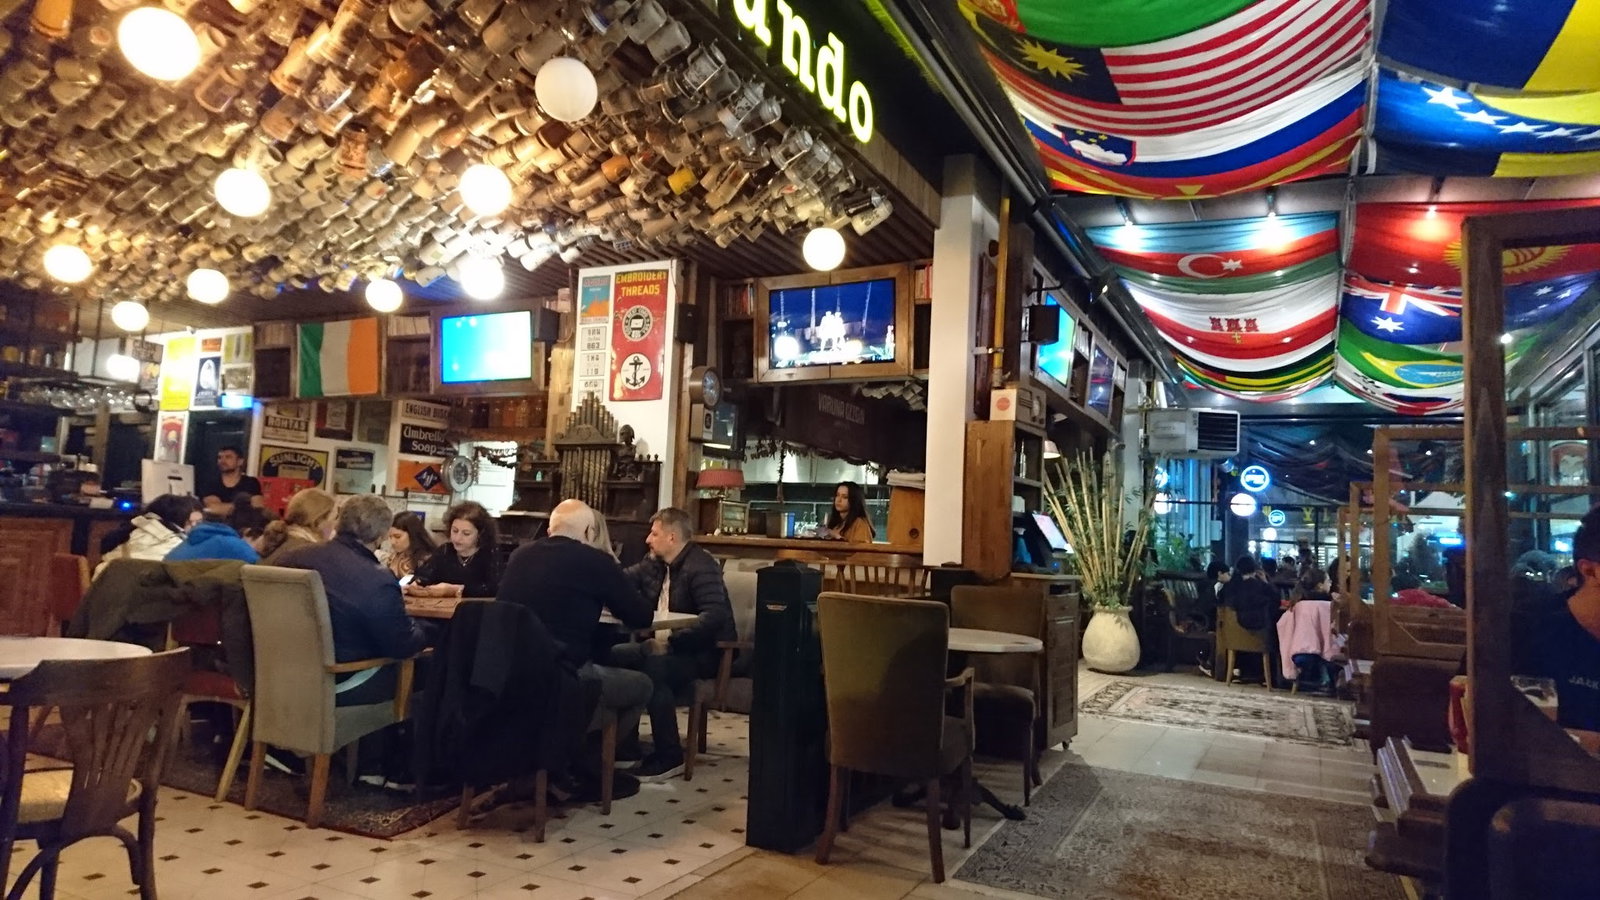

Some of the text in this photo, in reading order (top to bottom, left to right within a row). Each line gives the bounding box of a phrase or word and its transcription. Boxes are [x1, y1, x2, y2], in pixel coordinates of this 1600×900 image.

[621, 283, 661, 297] THREADS
[405, 402, 432, 417] ENGLISH
[411, 440, 437, 455] Soap
[269, 451, 320, 470] SUNLIGHT
